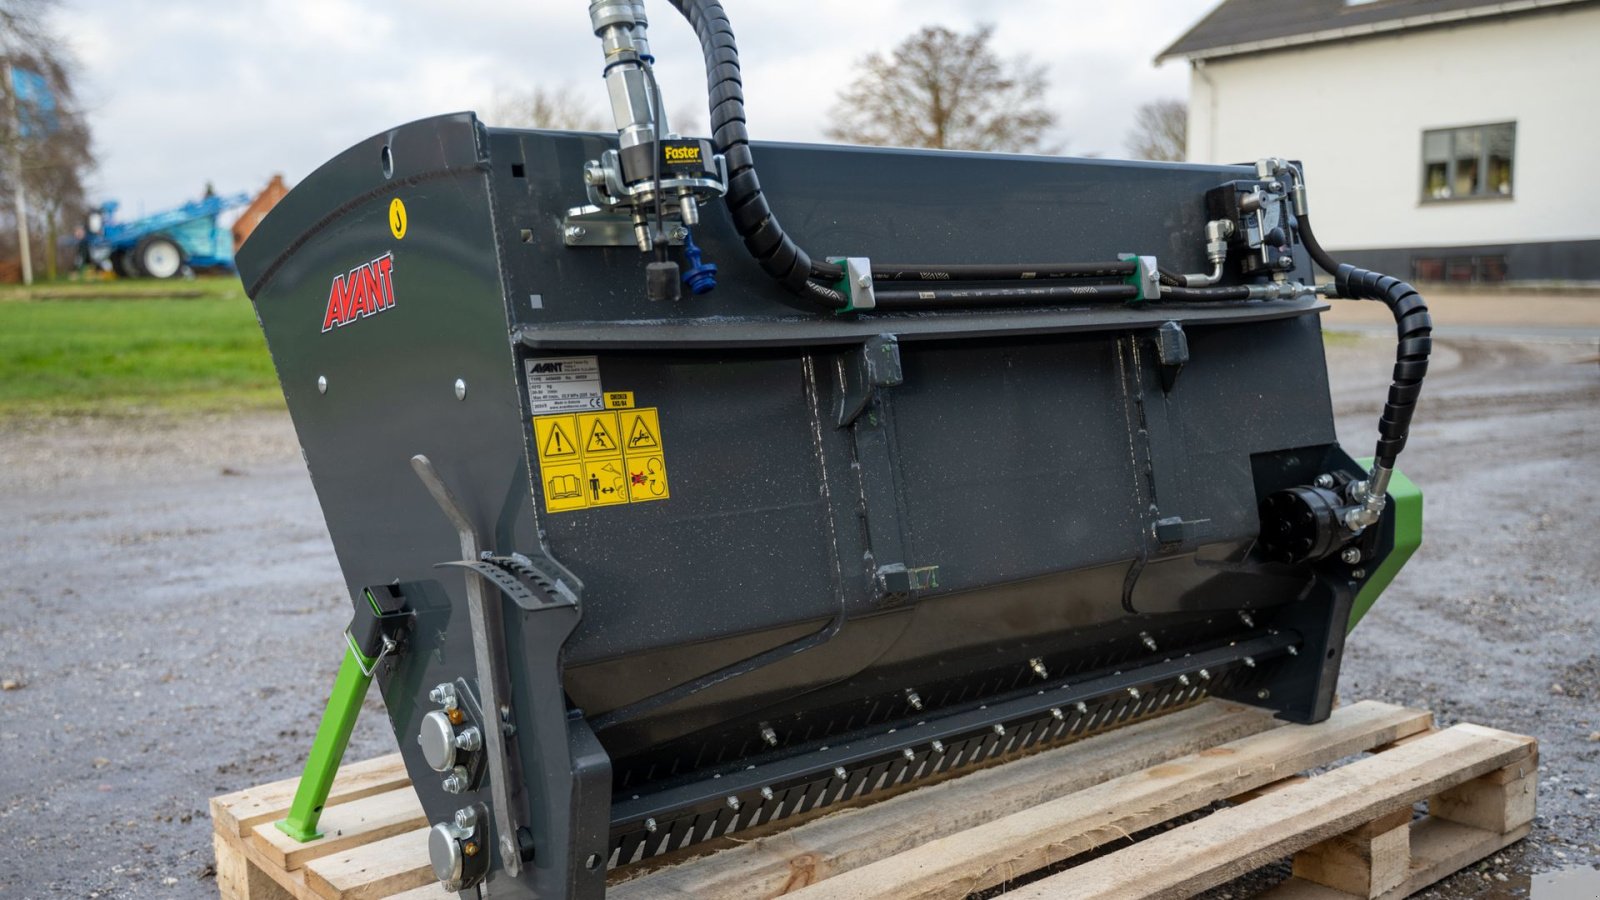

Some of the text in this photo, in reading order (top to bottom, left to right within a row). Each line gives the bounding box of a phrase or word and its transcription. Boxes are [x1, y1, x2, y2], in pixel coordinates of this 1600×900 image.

[665, 146, 700, 160] Faster
[321, 252, 395, 333] AVANT
[530, 362, 563, 373] AVANT
